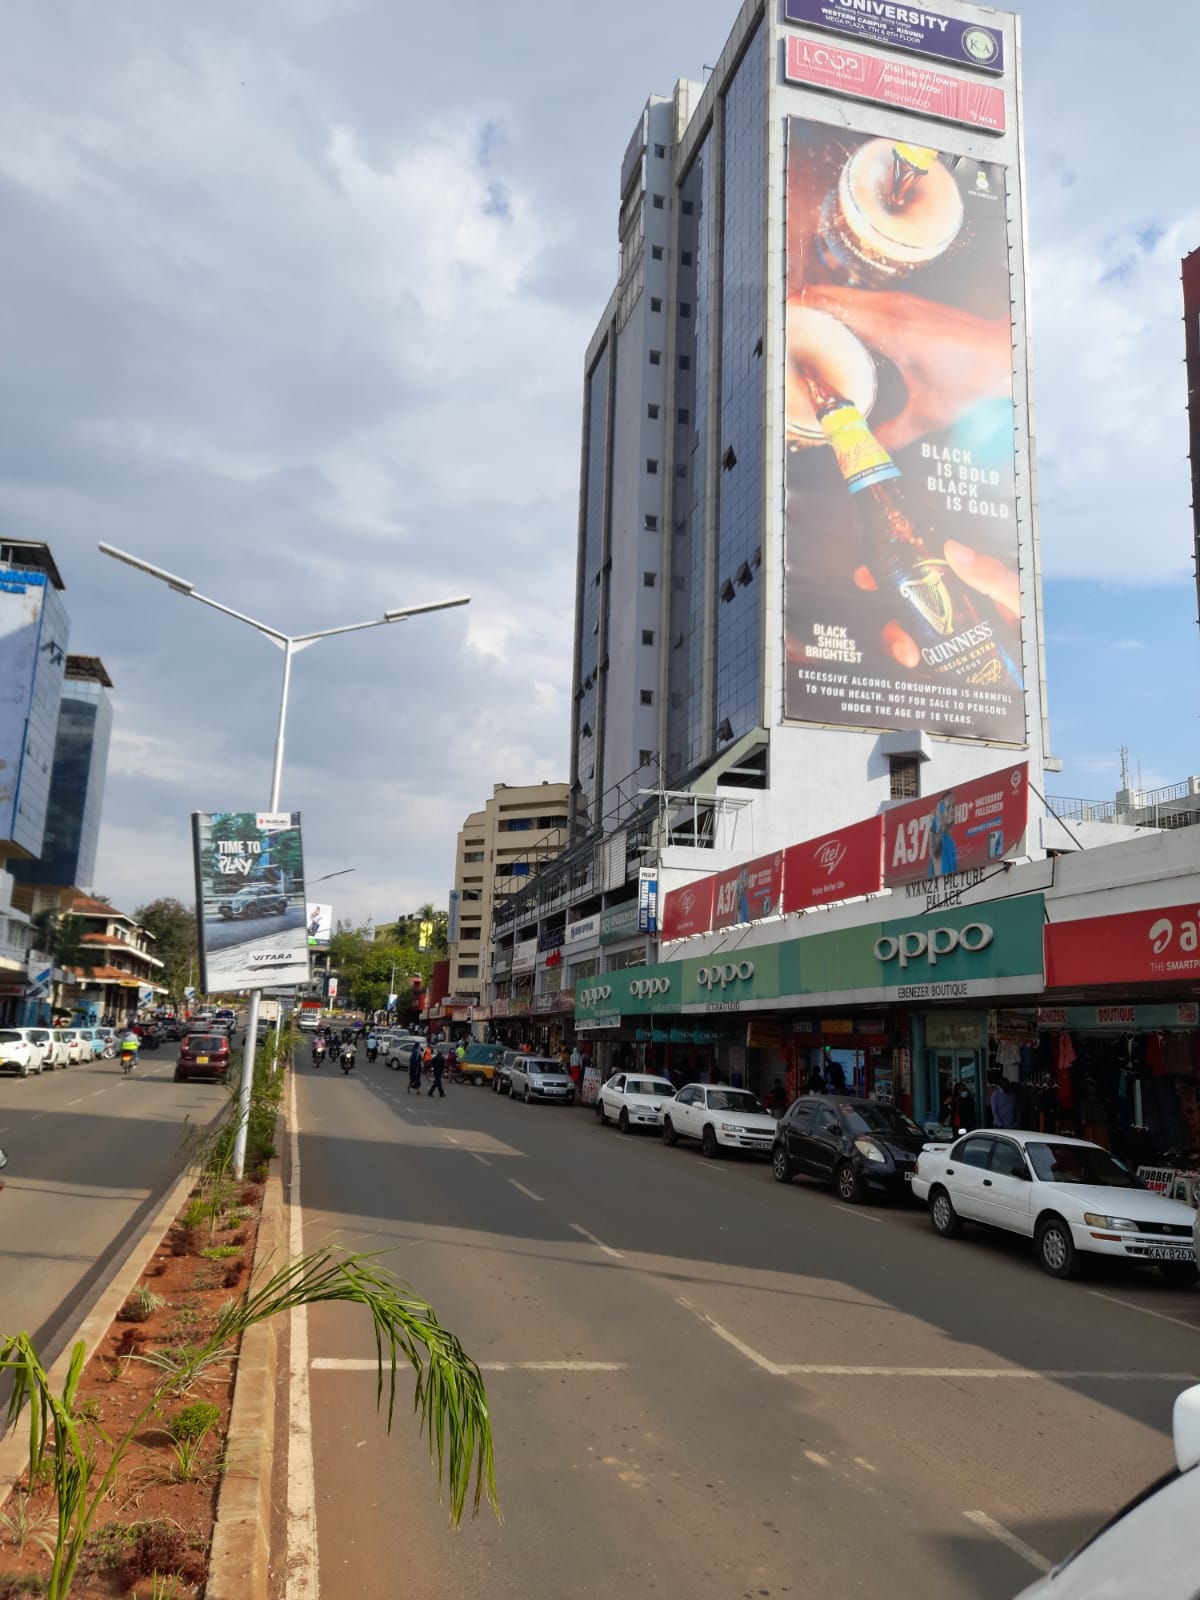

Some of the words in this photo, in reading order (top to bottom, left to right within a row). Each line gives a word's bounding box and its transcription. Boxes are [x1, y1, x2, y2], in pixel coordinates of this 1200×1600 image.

[821, 7, 857, 22] WESTERN
[857, 14, 888, 30] CAMPUS
[896, 24, 924, 39] KISUMU
[839, 0, 949, 32] UNIVERSITY
[825, 15, 845, 26] MEGA
[868, 25, 880, 34] 7TH
[886, 29, 899, 38] 8TH
[899, 32, 921, 45] FLOOR
[883, 74, 918, 88] ground
[884, 62, 904, 76] Visit
[905, 68, 918, 78] us
[919, 71, 932, 81] on
[932, 74, 960, 89] lower
[921, 443, 972, 464] BLACK
[937, 462, 952, 478] IS
[959, 465, 999, 485] BOLD
[927, 476, 978, 498] BLACK
[946, 496, 962, 511] IS
[968, 499, 1009, 519] GOLD
[813, 623, 847, 639] BLACK
[817, 635, 856, 651] SHINES
[921, 620, 993, 666] GUINNESS
[970, 641, 996, 659] EXTRA
[805, 645, 863, 664] BRIGHTEST
[956, 659, 982, 675] STOUT
[798, 669, 849, 685] EXCESSIVE
[851, 676, 892, 689] ALCOHOL
[895, 681, 958, 696] CONSUMPTION
[960, 689, 970, 698] IS
[973, 690, 1014, 704] HARMFUL
[805, 684, 817, 694] TO
[820, 686, 845, 697] YOUR
[848, 689, 886, 702] HEALTH.
[888, 694, 905, 704] NOT
[908, 696, 926, 706] FOR
[929, 698, 950, 709] SALE
[953, 701, 964, 711] TO
[967, 702, 1007, 716] PERSONS
[841, 702, 872, 714] UNDER
[875, 705, 892, 716] THE
[894, 707, 912, 718] AGE
[915, 710, 927, 720] OF
[930, 712, 941, 722] 18
[943, 713, 975, 725] YEARS.
[975, 802, 1004, 818] FULLSCREEN
[218, 841, 245, 854] TIME
[247, 841, 261, 854] TO
[892, 813, 934, 867] A37
[820, 842, 840, 863] itel
[219, 855, 252, 876] PLAY
[905, 878, 939, 899] NYANZA
[943, 866, 986, 891] PICTURE
[716, 880, 739, 916] A37
[926, 890, 962, 909] PALACE
[873, 923, 994, 968] oppo
[253, 953, 293, 961] VITARA
[1150, 961, 1166, 972] THE
[696, 961, 754, 990] oppo
[580, 984, 611, 1005] oppo
[629, 977, 671, 999] oppo
[898, 985, 929, 999] EBENEZER
[931, 983, 967, 997] BOUTIQUE
[1098, 1007, 1135, 1023] BOUTIQUE
[1139, 1169, 1173, 1183] RUBBER
